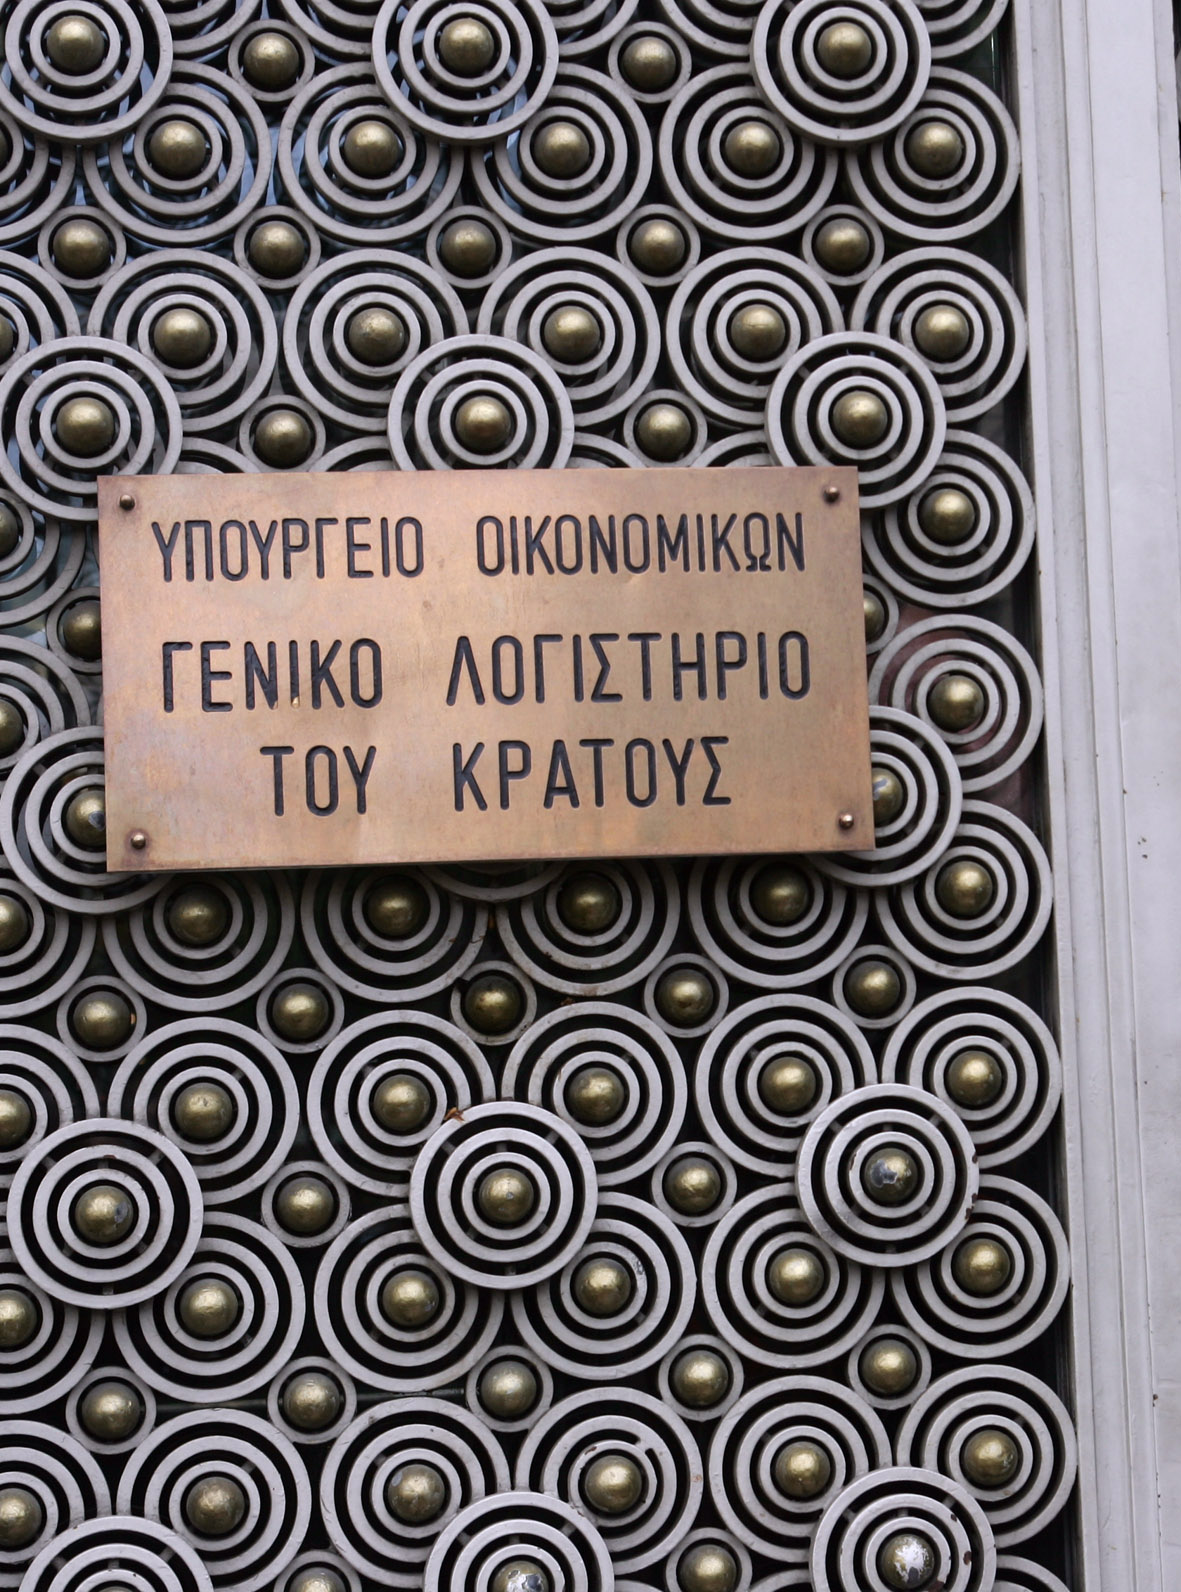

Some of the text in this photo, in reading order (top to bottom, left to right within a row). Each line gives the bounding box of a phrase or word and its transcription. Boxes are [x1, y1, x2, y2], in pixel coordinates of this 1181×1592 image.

[152, 511, 806, 582] ΥΠΟΥΡΓΕΙΟ ΟΙΚΟΝΟΜΙΚΩΝ
[162, 630, 811, 713] ΓΕΝΙΚΟ ΛΟΓΙΣΤΗΡΙΟ
[260, 735, 732, 817] ΤΟΥ ΚΡΑΤΟΥΣ
